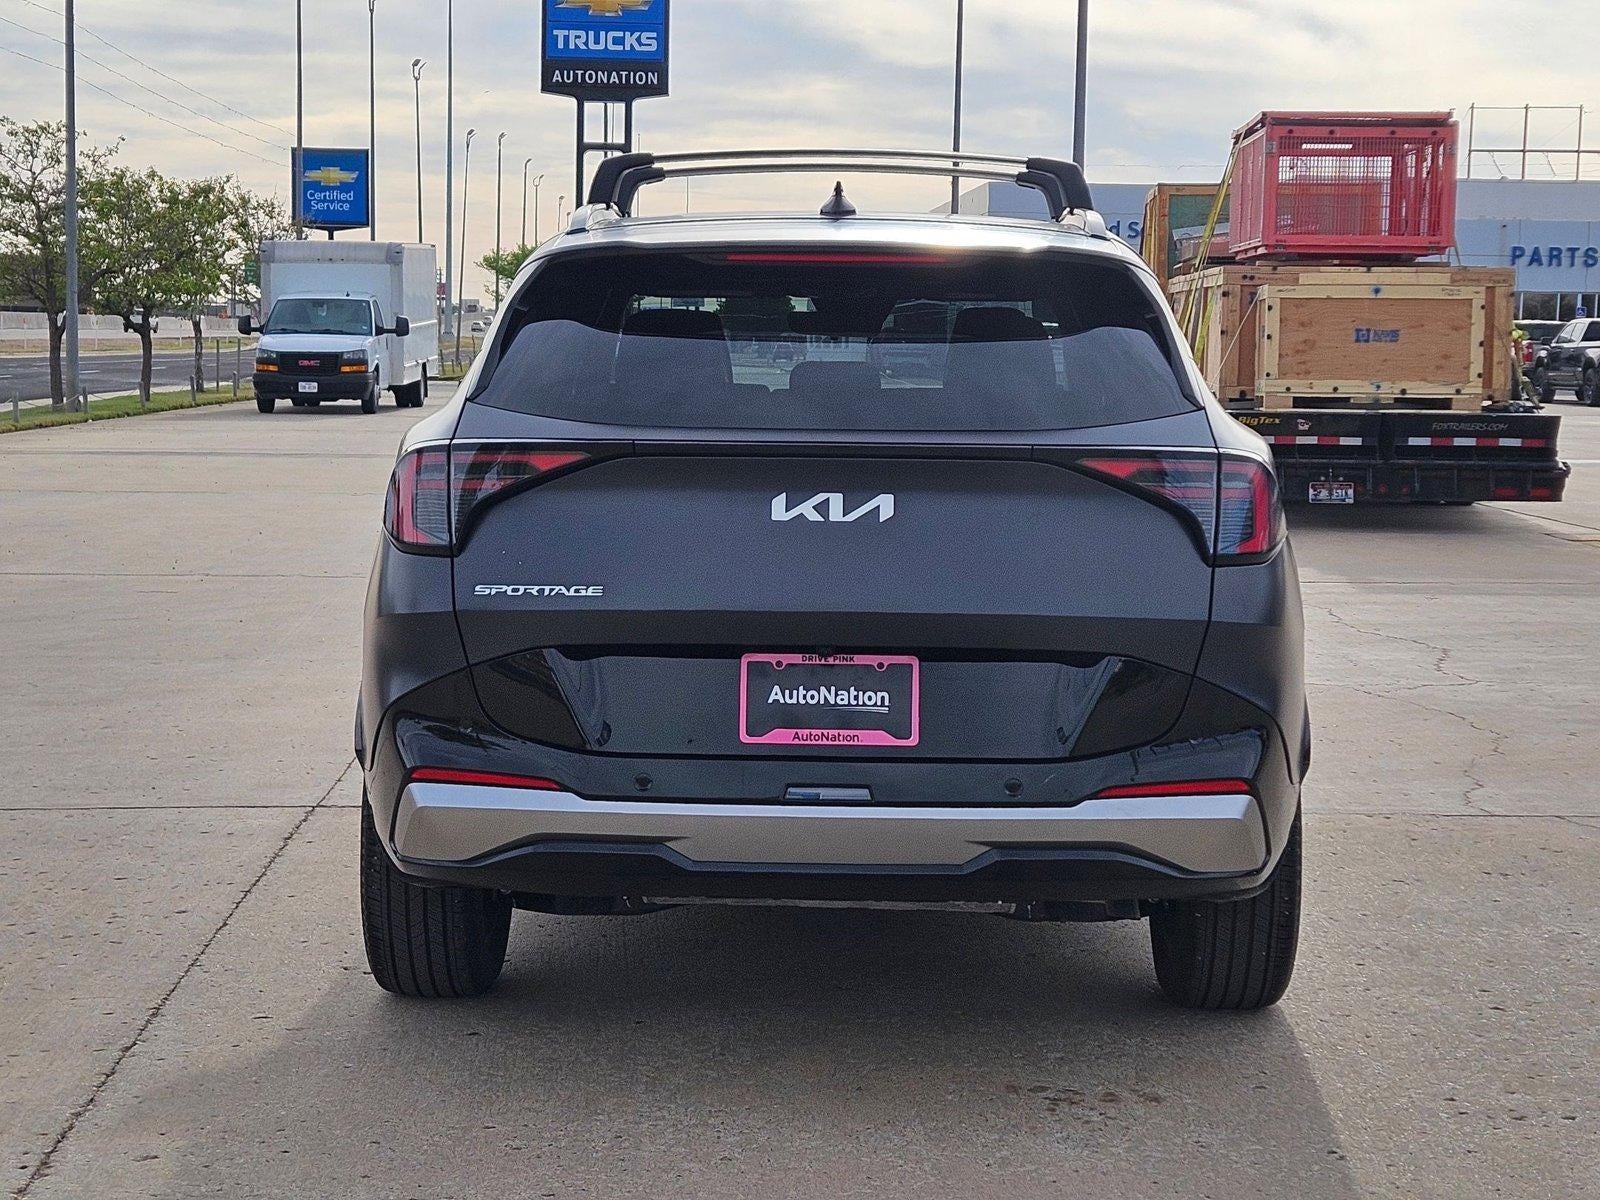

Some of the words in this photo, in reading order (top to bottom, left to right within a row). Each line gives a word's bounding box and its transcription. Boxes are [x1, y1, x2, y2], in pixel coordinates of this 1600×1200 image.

[553, 29, 658, 52] TRUCKS
[552, 69, 659, 85] AUTONATION
[307, 190, 354, 200] Certified
[311, 200, 350, 211] Service
[1510, 245, 1599, 268] PARTS
[771, 491, 895, 523] KIA
[474, 584, 604, 597] SPORTAGE
[801, 655, 830, 663] DRIVE
[832, 655, 855, 663] PINK
[768, 685, 890, 706] AutoNation
[792, 731, 860, 743] AutoNation
